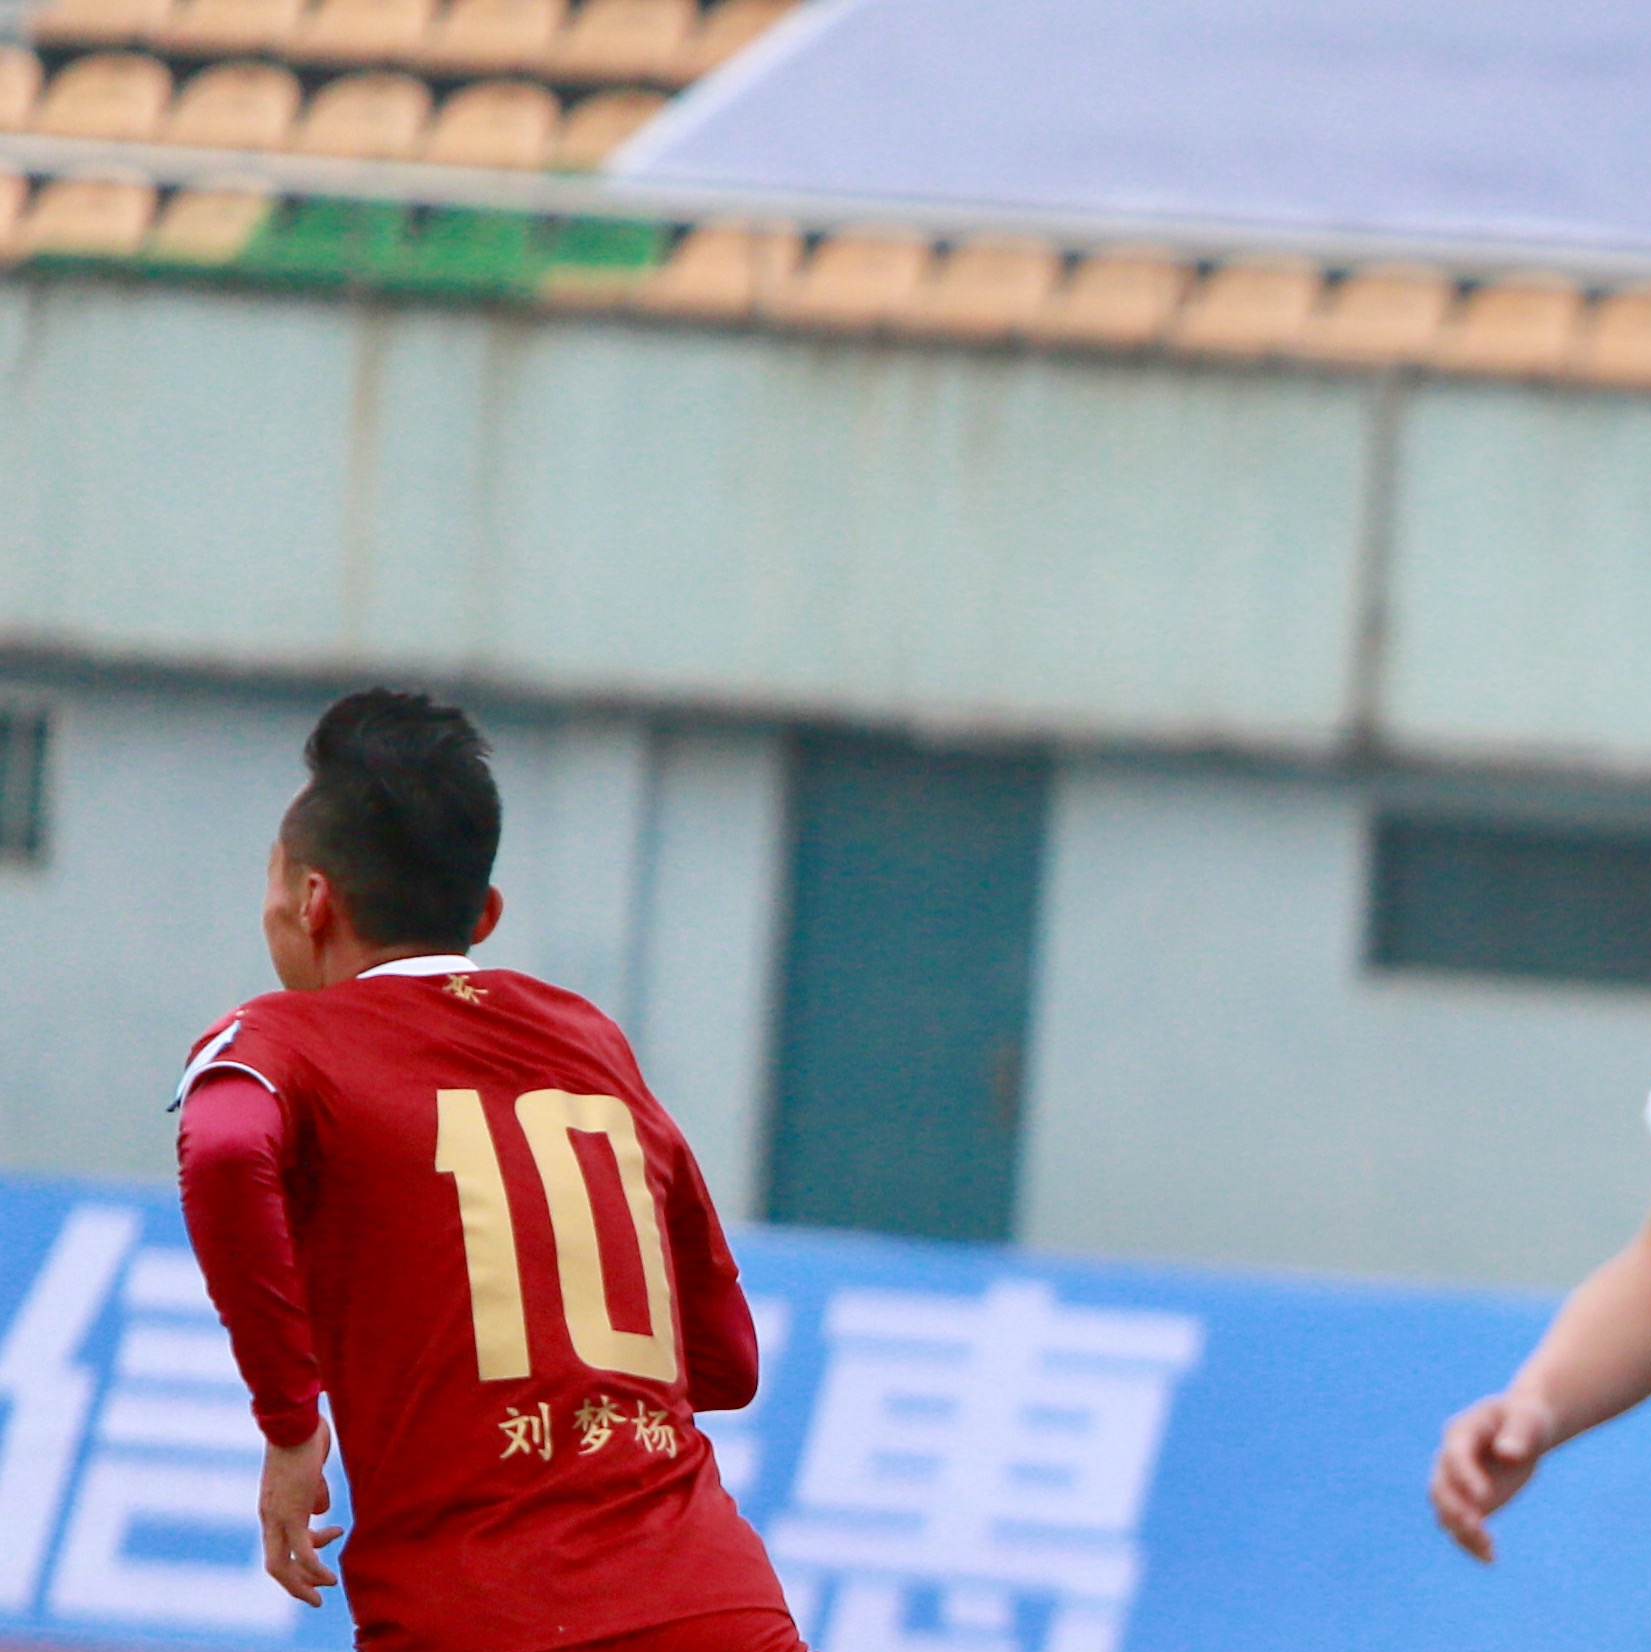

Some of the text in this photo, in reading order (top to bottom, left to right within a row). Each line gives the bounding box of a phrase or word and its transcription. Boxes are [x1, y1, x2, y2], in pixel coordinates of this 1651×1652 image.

[435, 1088, 678, 1383] 10
[498, 1394, 678, 1461] 刘梦杨
